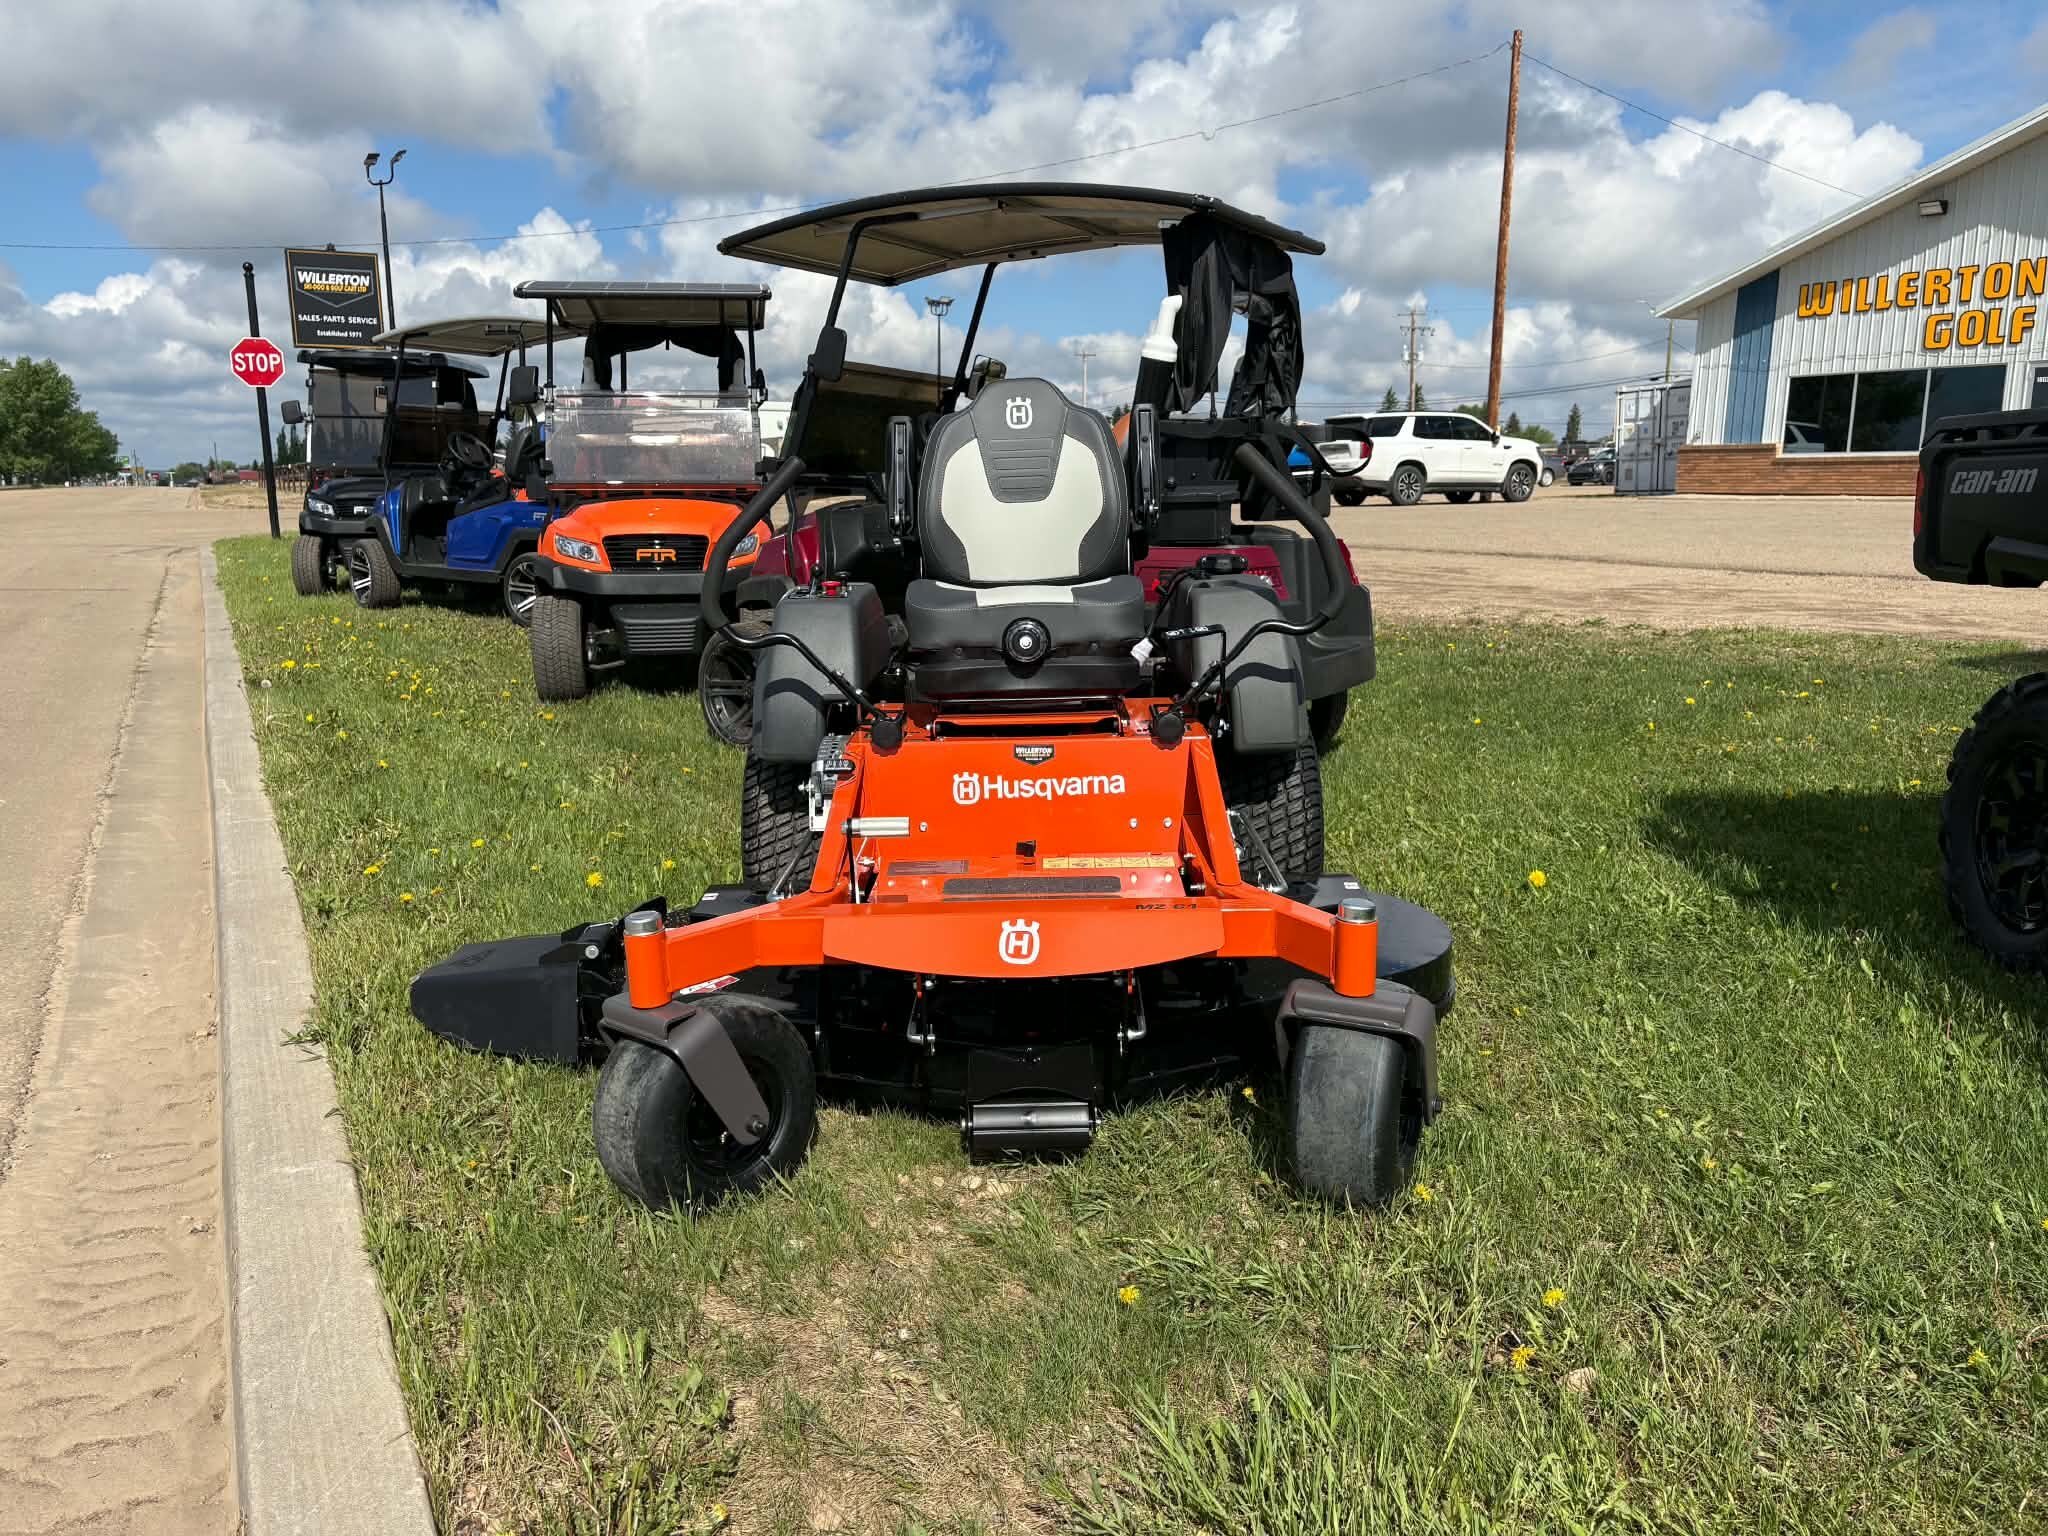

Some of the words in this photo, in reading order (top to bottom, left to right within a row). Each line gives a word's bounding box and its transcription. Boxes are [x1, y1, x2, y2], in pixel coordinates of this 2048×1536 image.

[297, 271, 370, 286] WILLERTON
[1798, 257, 2048, 318] WILLERTON
[348, 317, 378, 325] SERVICE
[1924, 306, 2037, 350] GOLF
[234, 352, 281, 373] STOP
[1950, 468, 2039, 494] can-am
[636, 548, 677, 563] FTR
[983, 774, 1126, 801] Husqvarna
